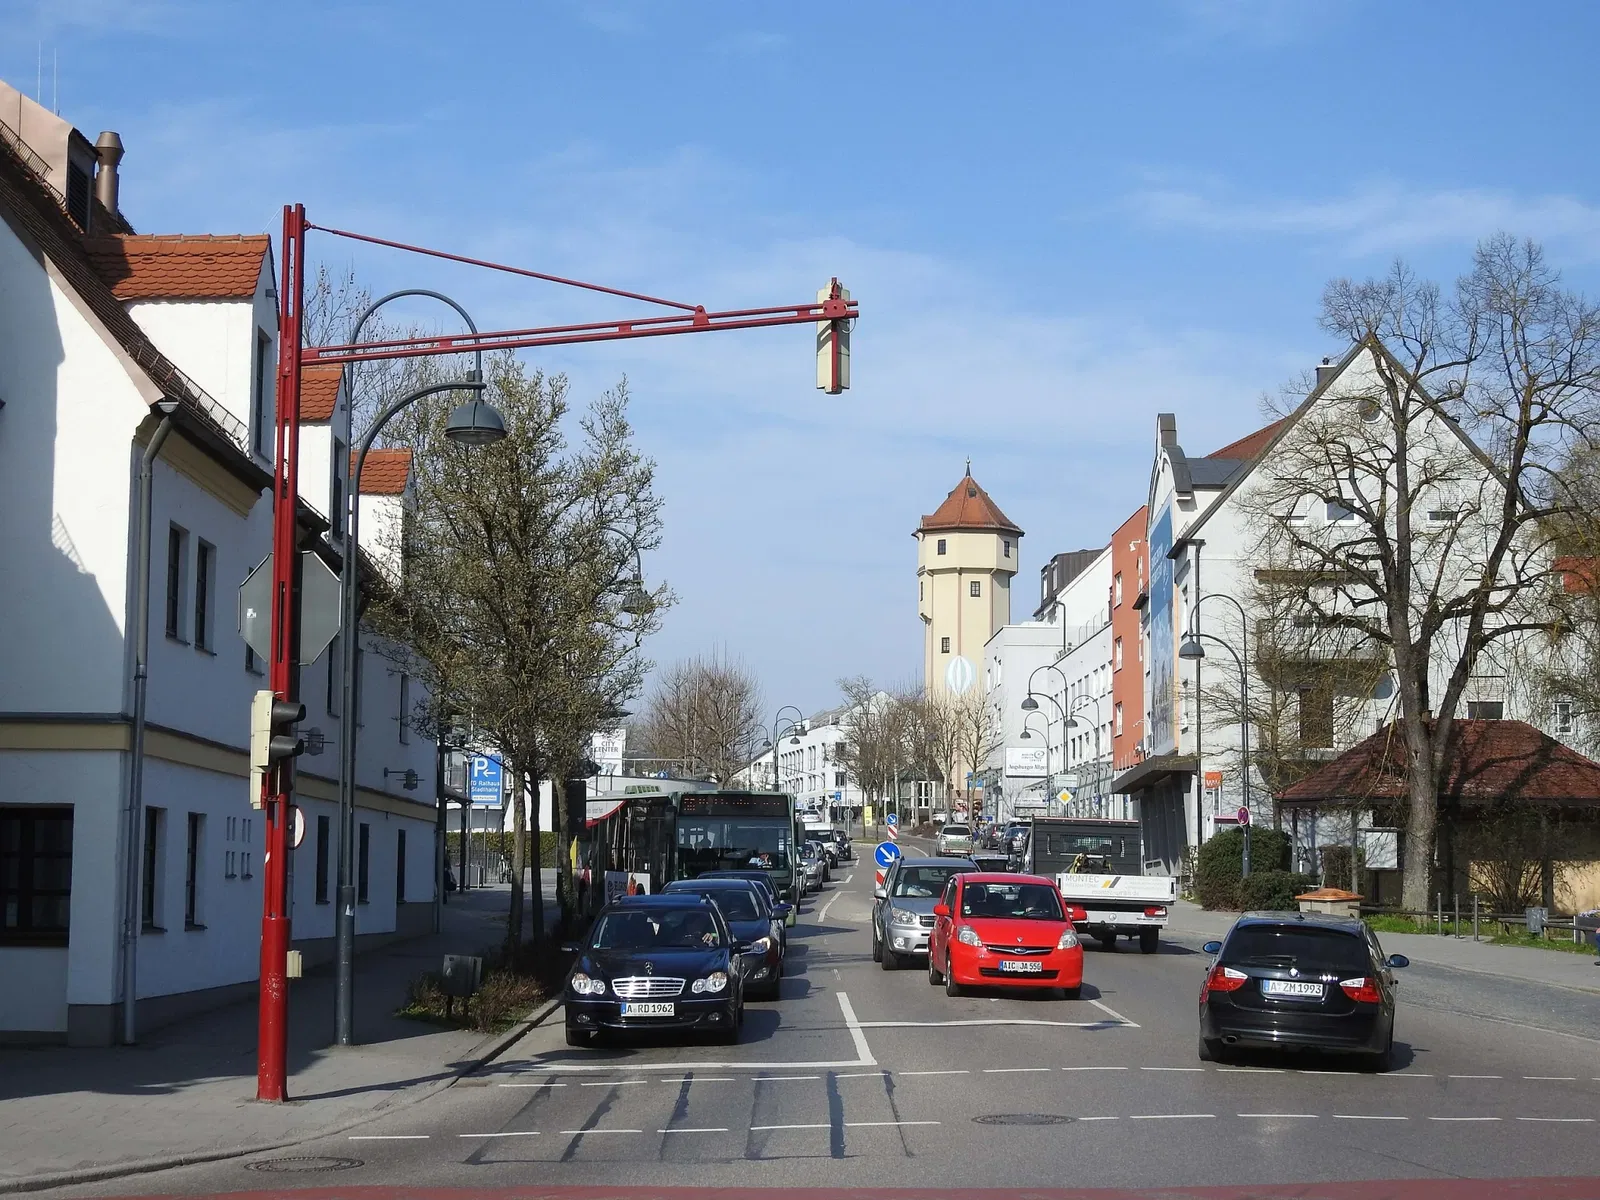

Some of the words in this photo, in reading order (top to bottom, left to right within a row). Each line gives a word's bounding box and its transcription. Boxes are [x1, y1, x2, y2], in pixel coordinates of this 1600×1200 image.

[473, 757, 489, 778] P
[1065, 874, 1100, 883] MONTEC
[1003, 961, 1016, 970] AIC
[1270, 982, 1277, 991] A
[1282, 983, 1296, 992] ZM
[1297, 983, 1322, 994] 1993
[626, 1004, 633, 1013] A
[637, 1004, 650, 1013] RD
[651, 1004, 673, 1013] 1962
